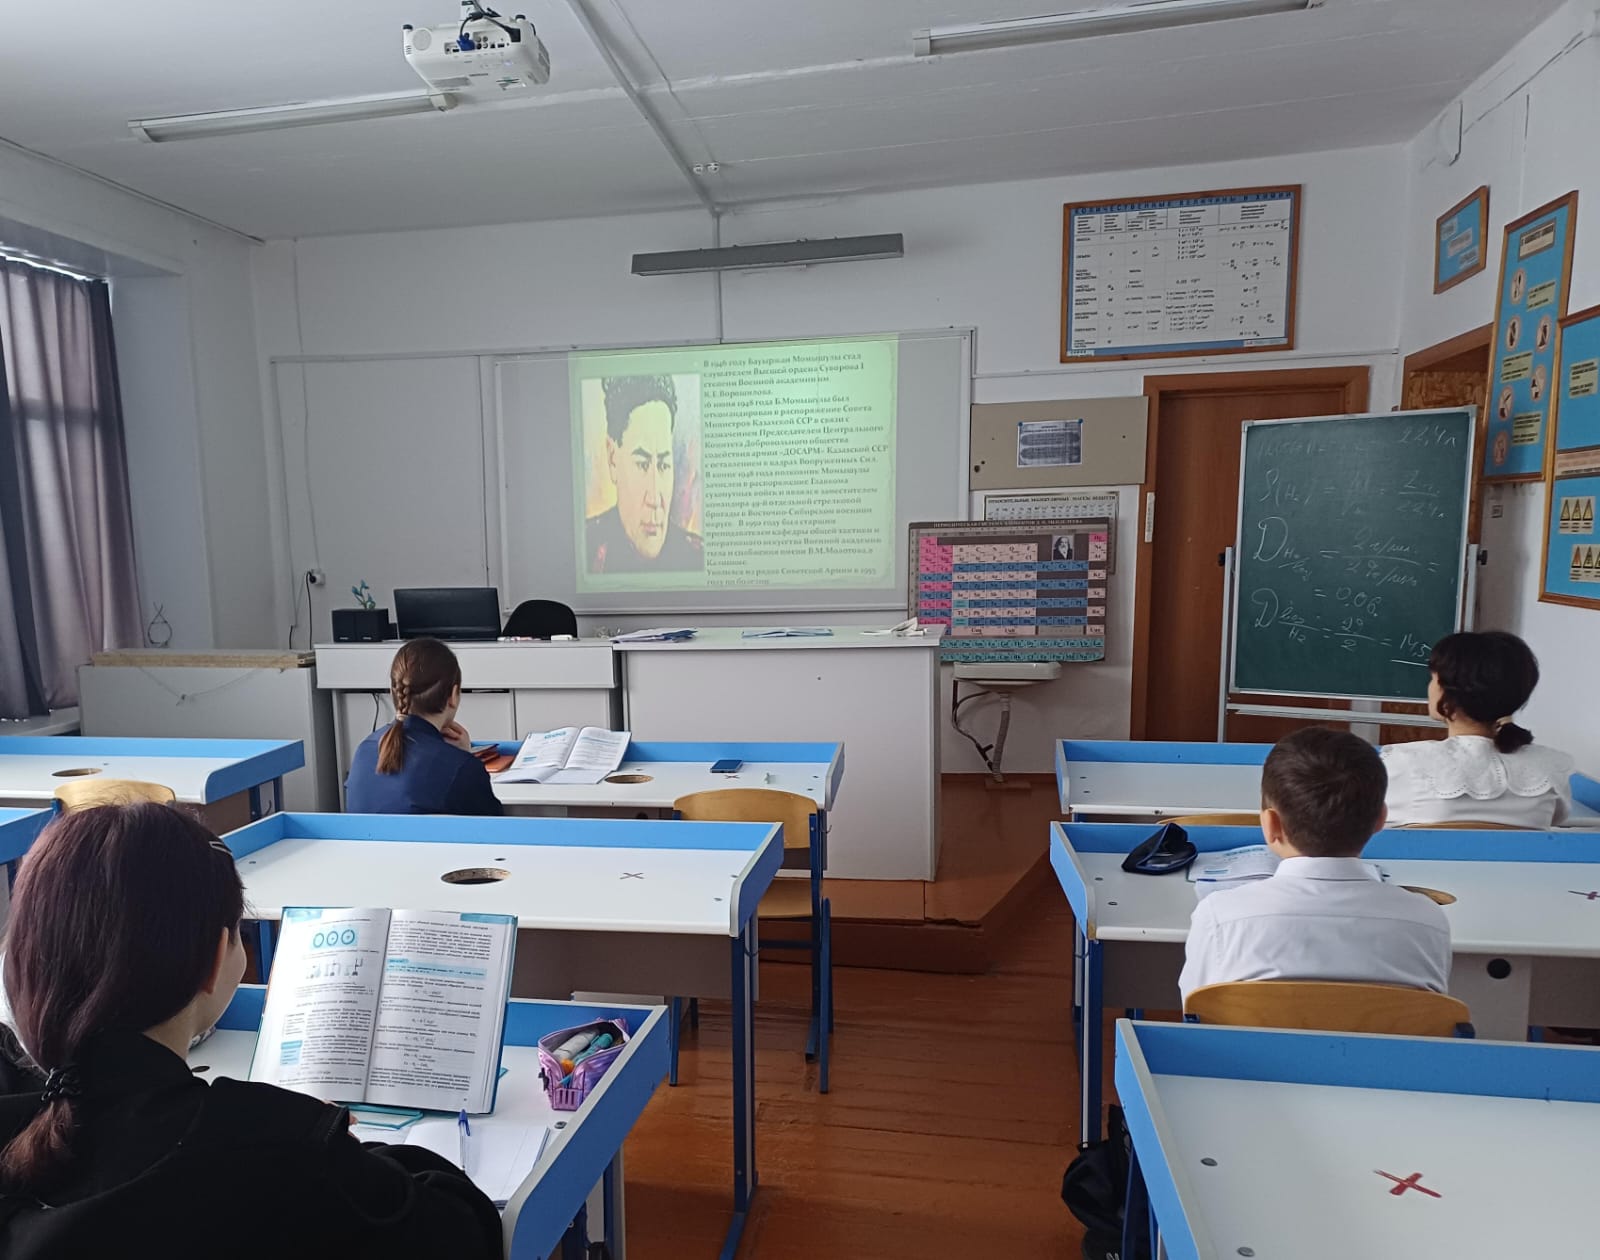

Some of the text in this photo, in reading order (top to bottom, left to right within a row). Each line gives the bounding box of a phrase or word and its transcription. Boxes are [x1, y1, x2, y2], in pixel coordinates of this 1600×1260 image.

[819, 363, 859, 374] Суворова
[739, 376, 774, 385] Военной
[832, 394, 850, 402] был
[842, 403, 872, 412] Совета
[752, 417, 794, 426] Казахской
[795, 416, 813, 424] ССР
[759, 426, 821, 438] Председателем
[809, 435, 849, 445] общества
[871, 444, 888, 452] ССР
